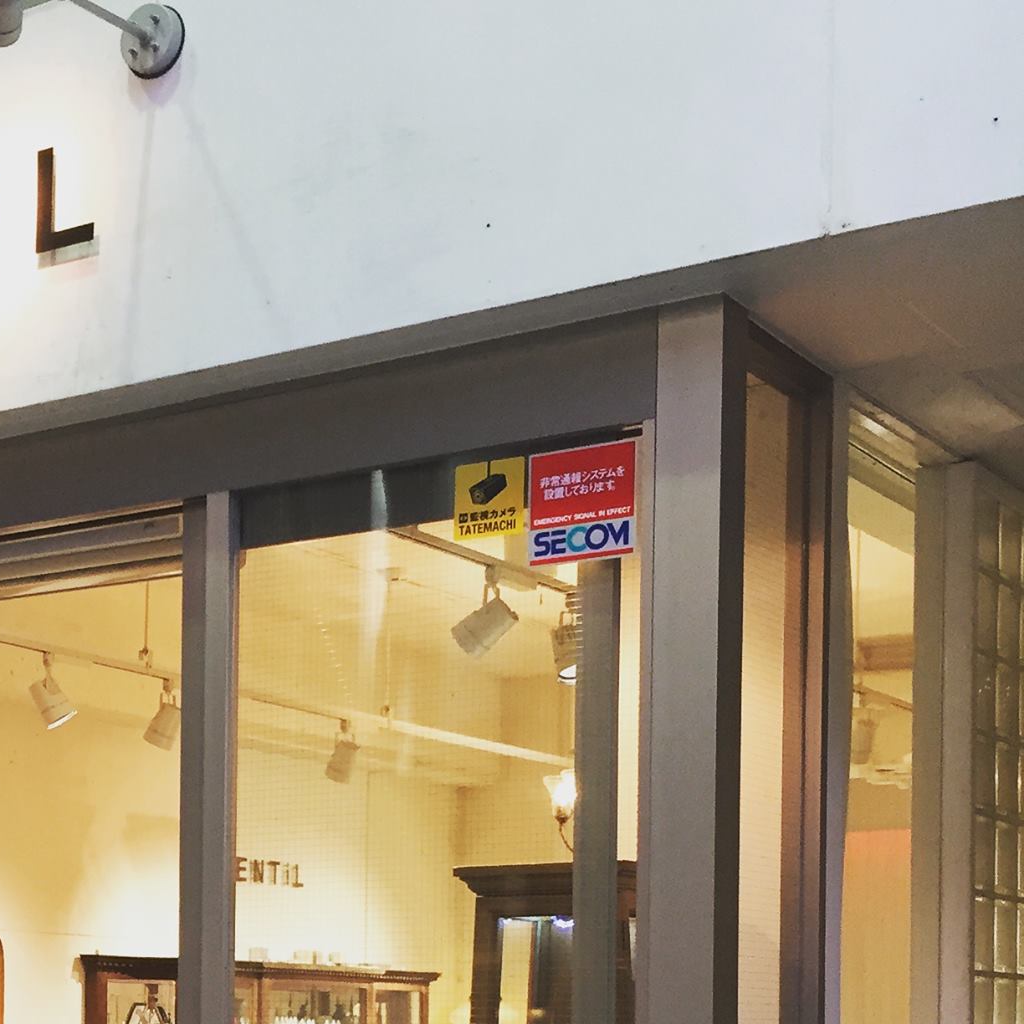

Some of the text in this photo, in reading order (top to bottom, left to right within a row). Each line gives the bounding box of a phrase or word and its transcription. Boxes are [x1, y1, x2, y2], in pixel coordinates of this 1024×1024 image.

[459, 518, 517, 536] TATEMACHI
[533, 514, 572, 526] EMERGENCY
[574, 511, 596, 520] SIGNAL
[534, 520, 630, 558] SECOM
